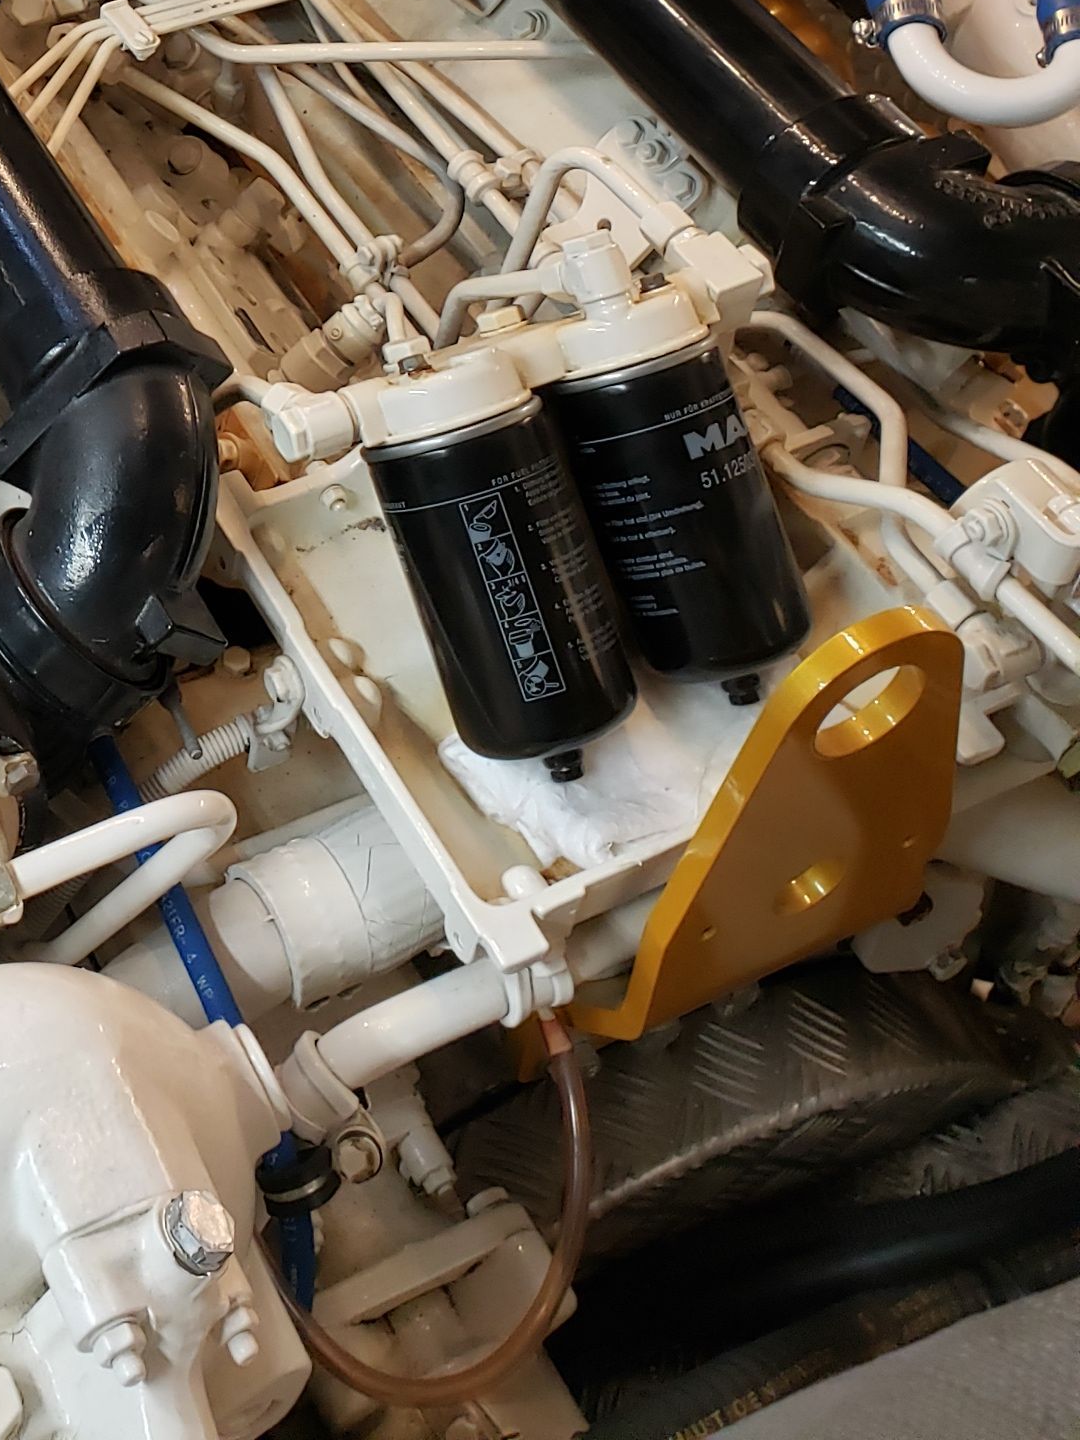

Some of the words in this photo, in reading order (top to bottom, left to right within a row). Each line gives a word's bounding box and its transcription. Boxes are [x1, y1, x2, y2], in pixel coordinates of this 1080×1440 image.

[664, 409, 682, 421] NUR
[683, 414, 748, 460] MA
[491, 474, 509, 487] FOR
[510, 468, 530, 480] FUEL
[197, 975, 214, 999] WP
